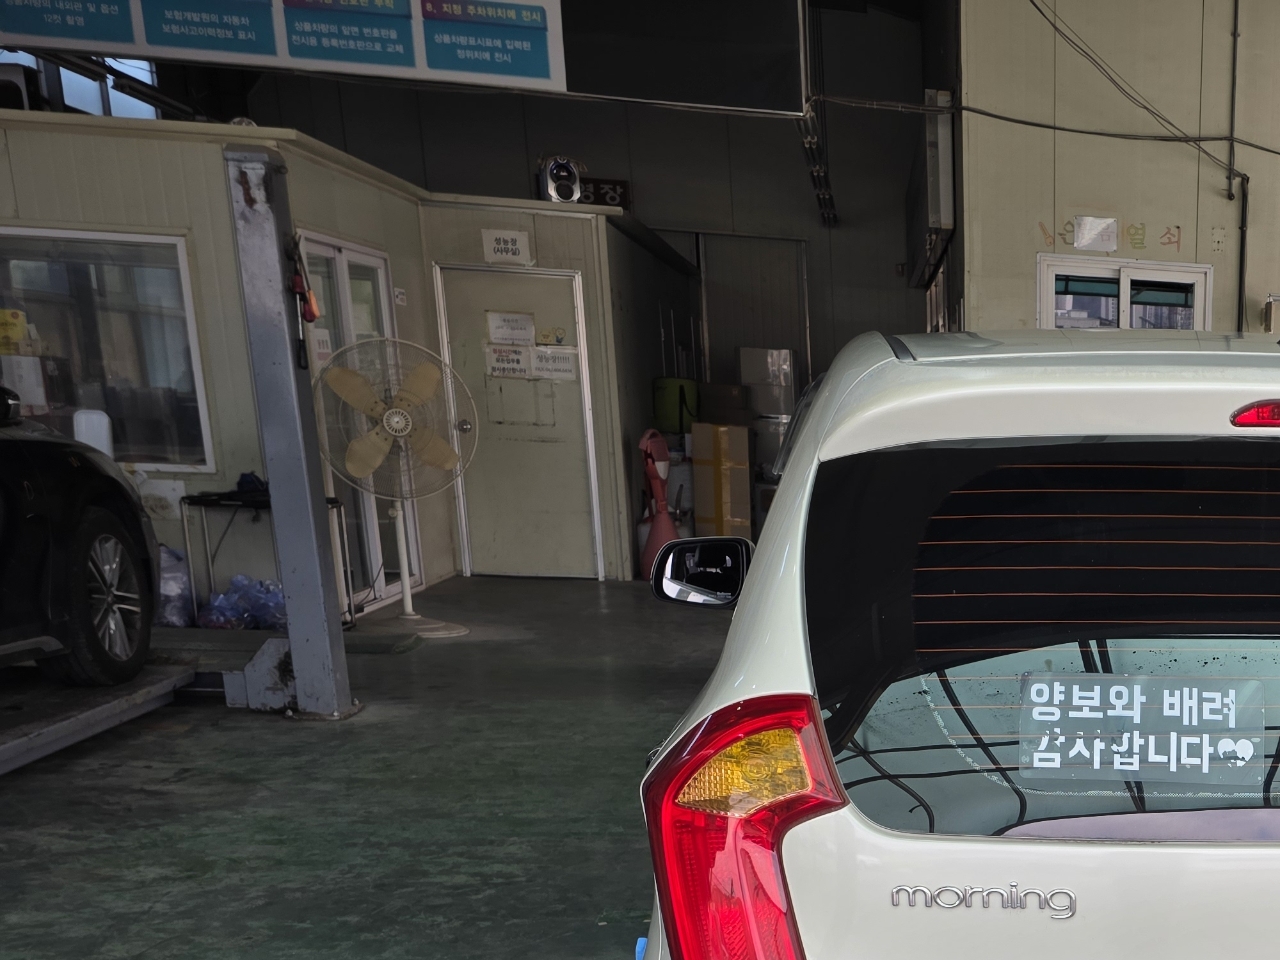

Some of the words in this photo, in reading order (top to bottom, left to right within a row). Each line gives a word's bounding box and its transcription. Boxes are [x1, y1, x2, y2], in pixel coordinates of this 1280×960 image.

[222, 15, 250, 26] 자동차
[521, 10, 541, 22] 전시
[294, 21, 338, 34] 상품차량의
[237, 30, 256, 41] 표시
[1030, 681, 1147, 724] 양보와
[1163, 687, 1236, 729] 배려
[891, 880, 1077, 920] morning
